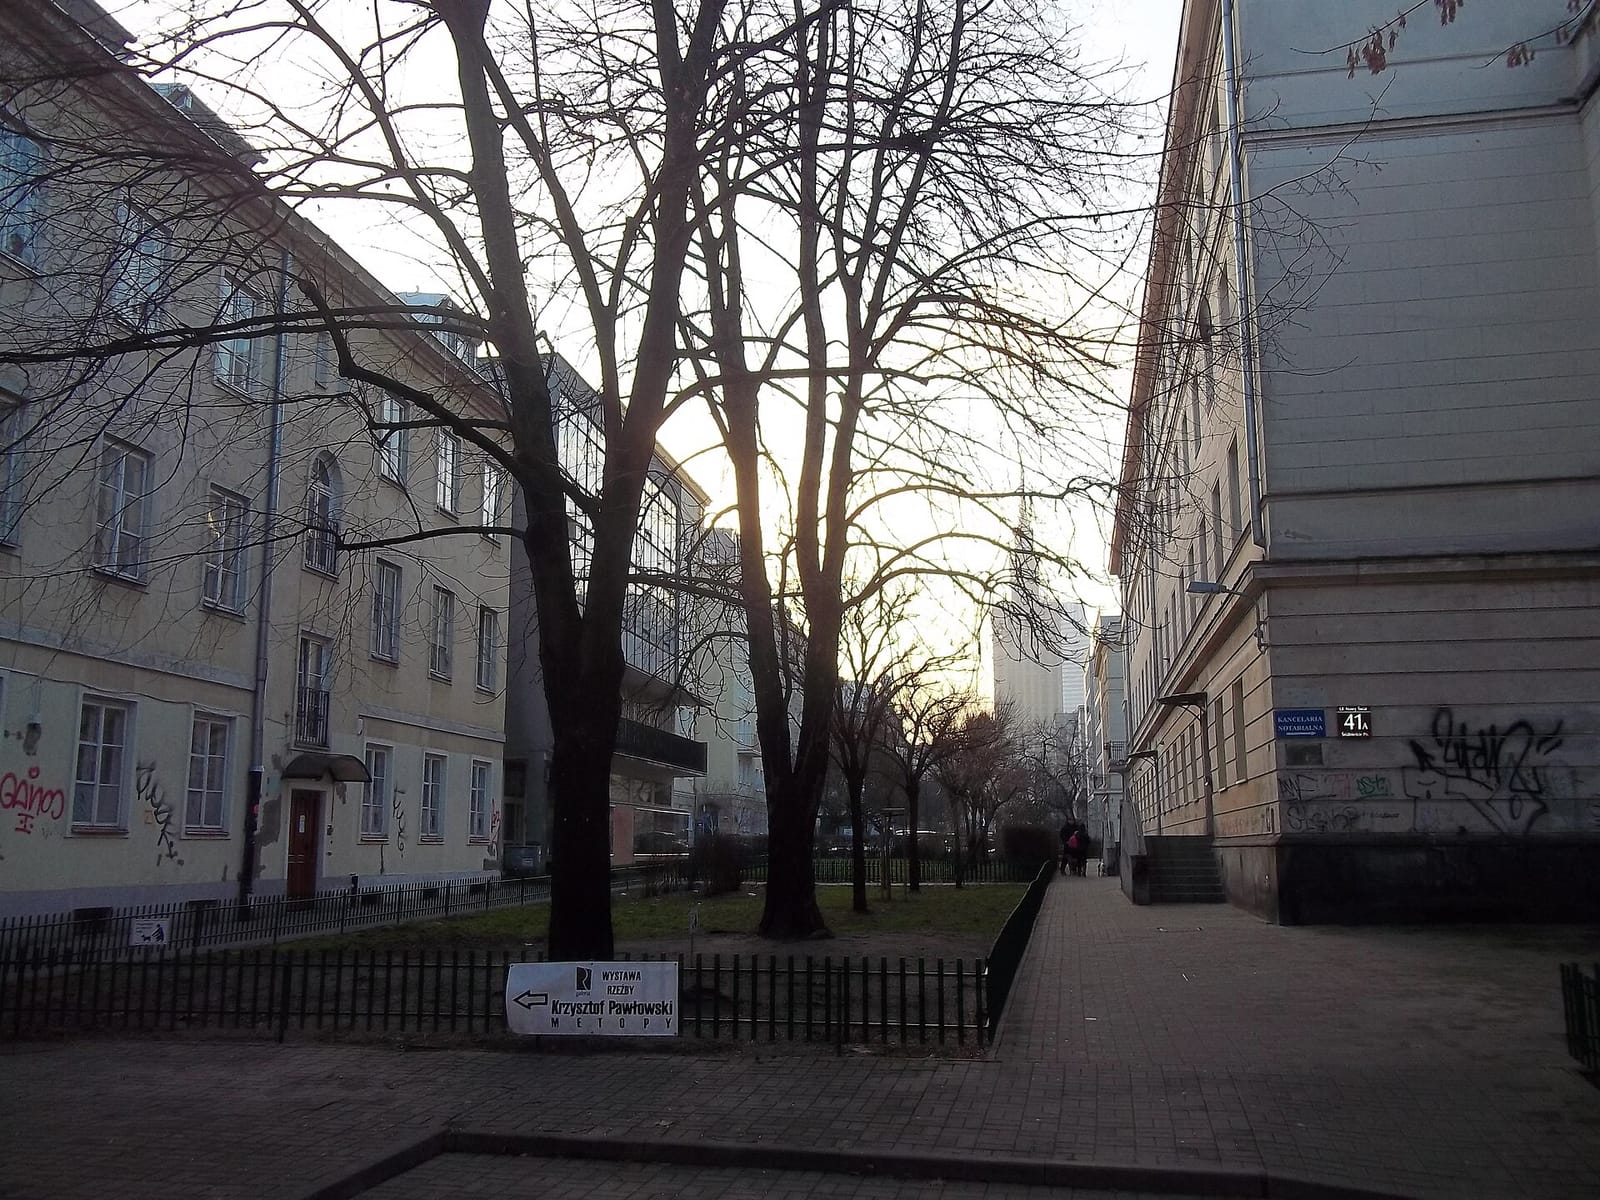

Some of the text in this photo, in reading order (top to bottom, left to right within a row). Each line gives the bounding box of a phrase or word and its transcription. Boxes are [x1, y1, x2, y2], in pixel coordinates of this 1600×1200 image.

[1277, 715, 1323, 723] KANCELARIA
[1278, 724, 1324, 732] NOTARIALNA
[602, 970, 641, 981] WYSTAWA
[607, 984, 635, 996] RZEŹBY
[551, 1000, 673, 1017] Krzysztof Pawłowski
[551, 1017, 672, 1029] METOPY
